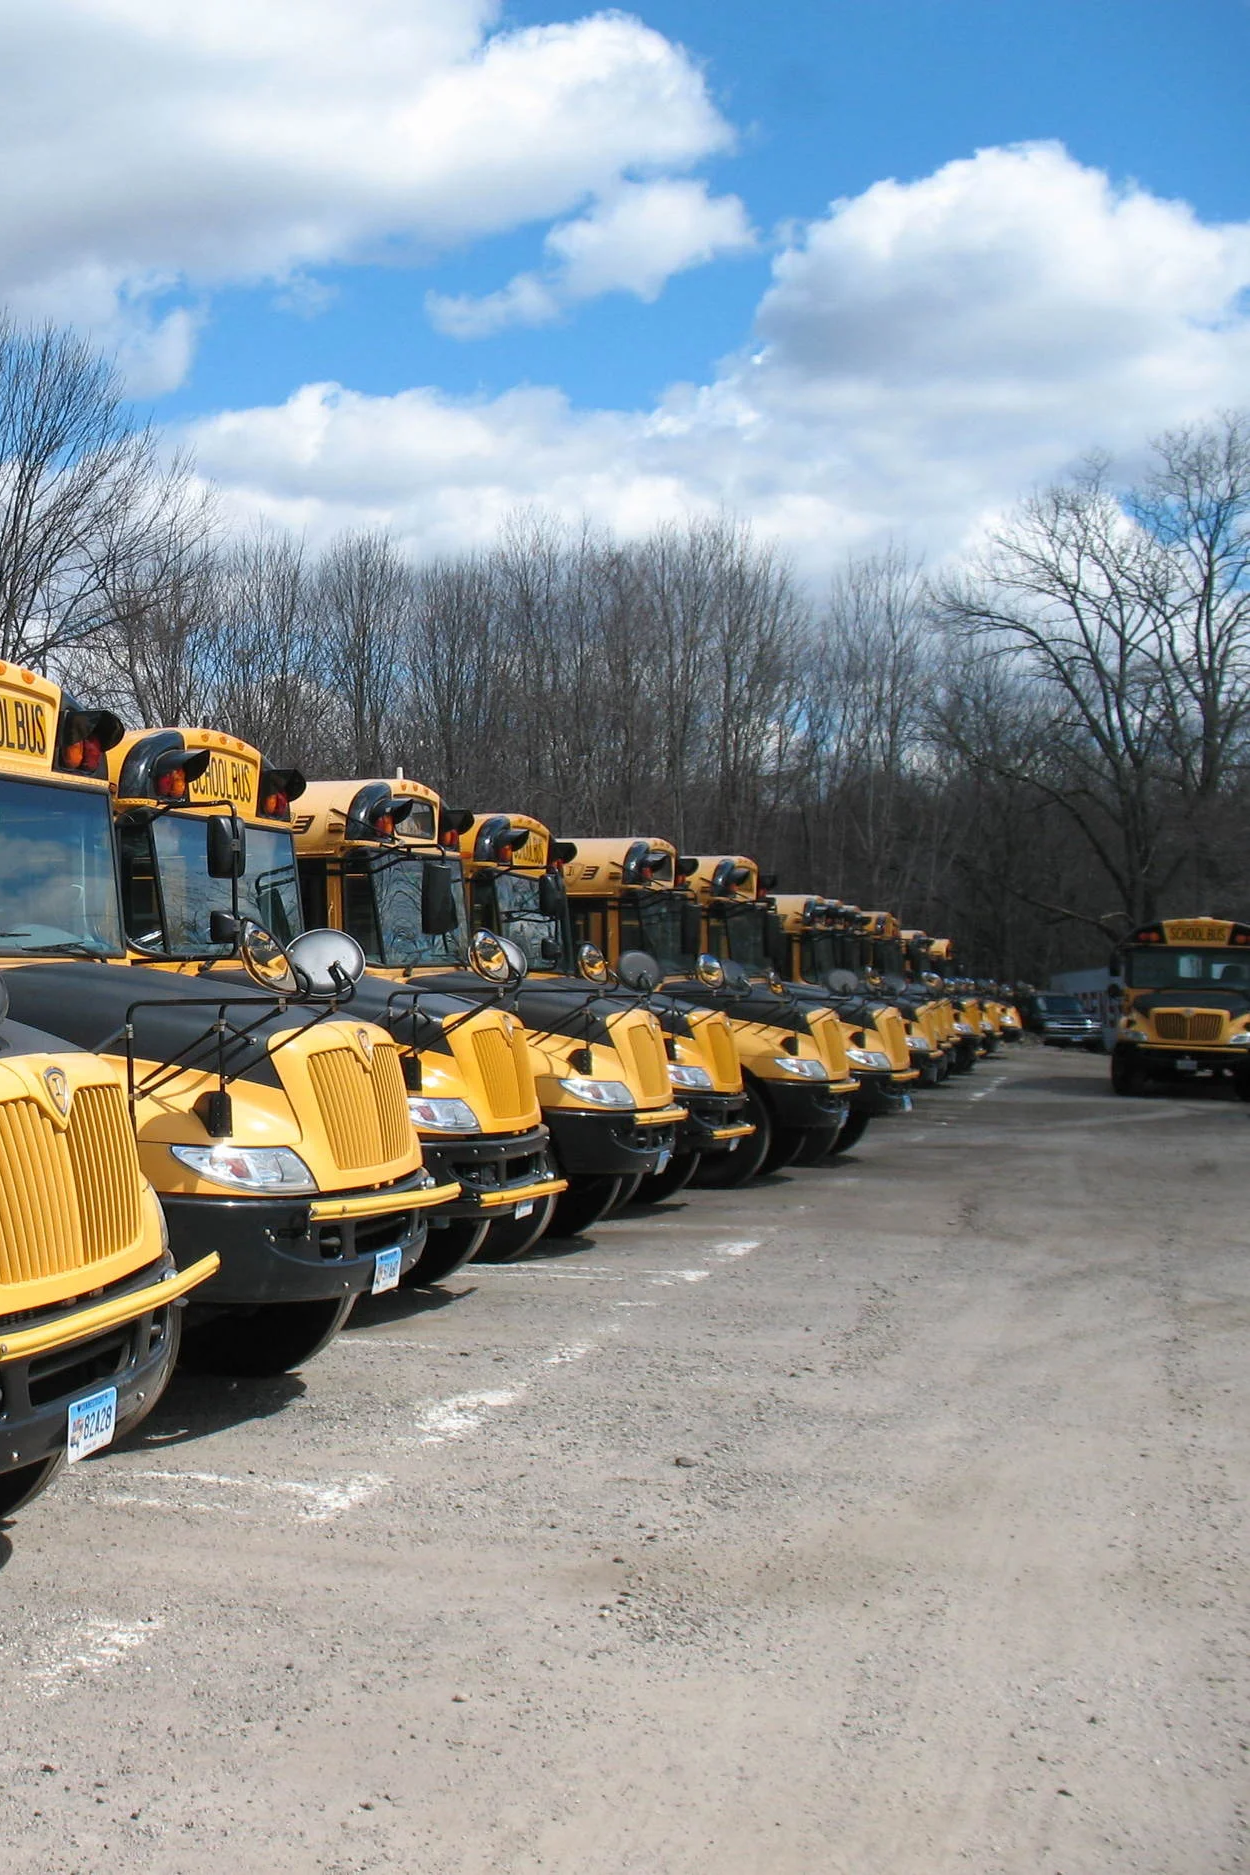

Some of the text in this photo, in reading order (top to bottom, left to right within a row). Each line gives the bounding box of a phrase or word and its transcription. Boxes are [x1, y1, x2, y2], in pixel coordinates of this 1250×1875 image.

[14, 700, 46, 756] BUS
[192, 757, 252, 803] HOOL BUS
[83, 1405, 113, 1440] 82A28
